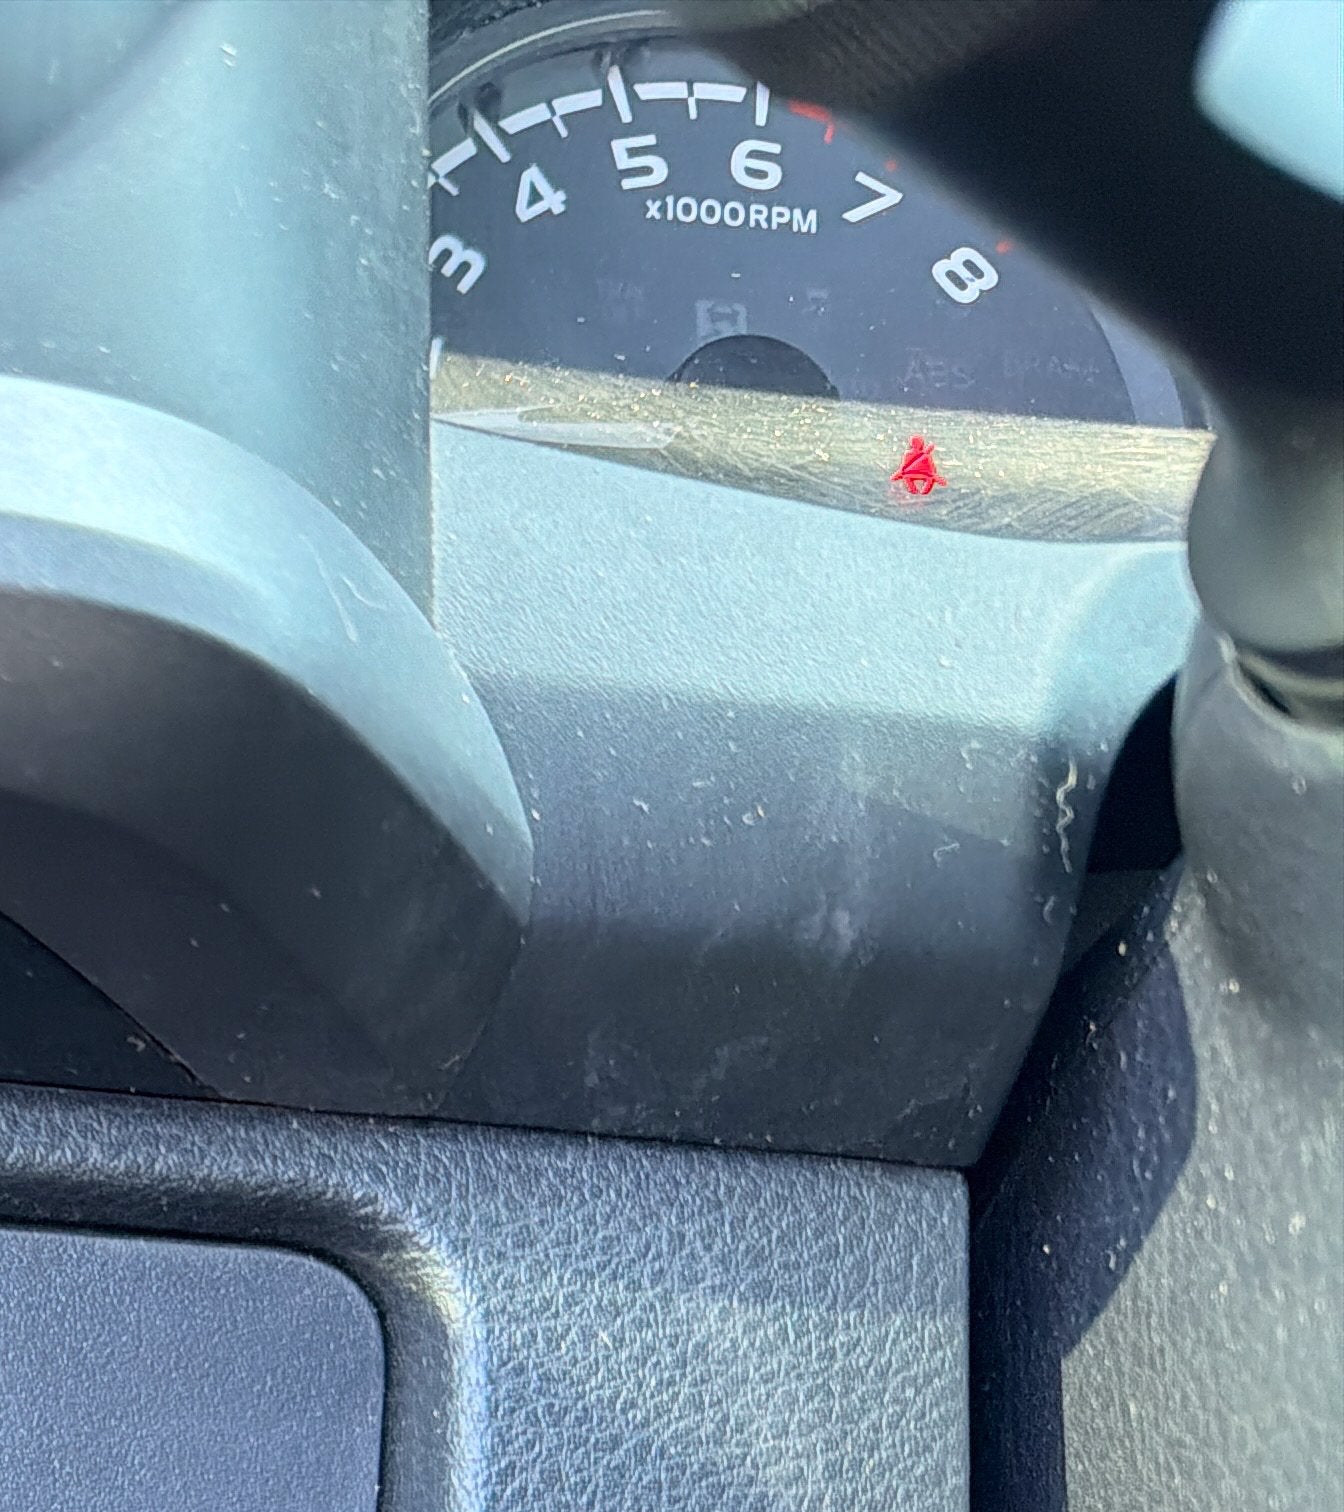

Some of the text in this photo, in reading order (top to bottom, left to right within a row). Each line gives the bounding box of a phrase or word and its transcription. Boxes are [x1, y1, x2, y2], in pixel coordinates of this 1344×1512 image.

[612, 134, 669, 190] 5
[730, 139, 783, 191] 6
[515, 163, 567, 223] 4
[842, 171, 904, 223] 7
[427, 234, 487, 295] 3
[932, 246, 999, 305] 8
